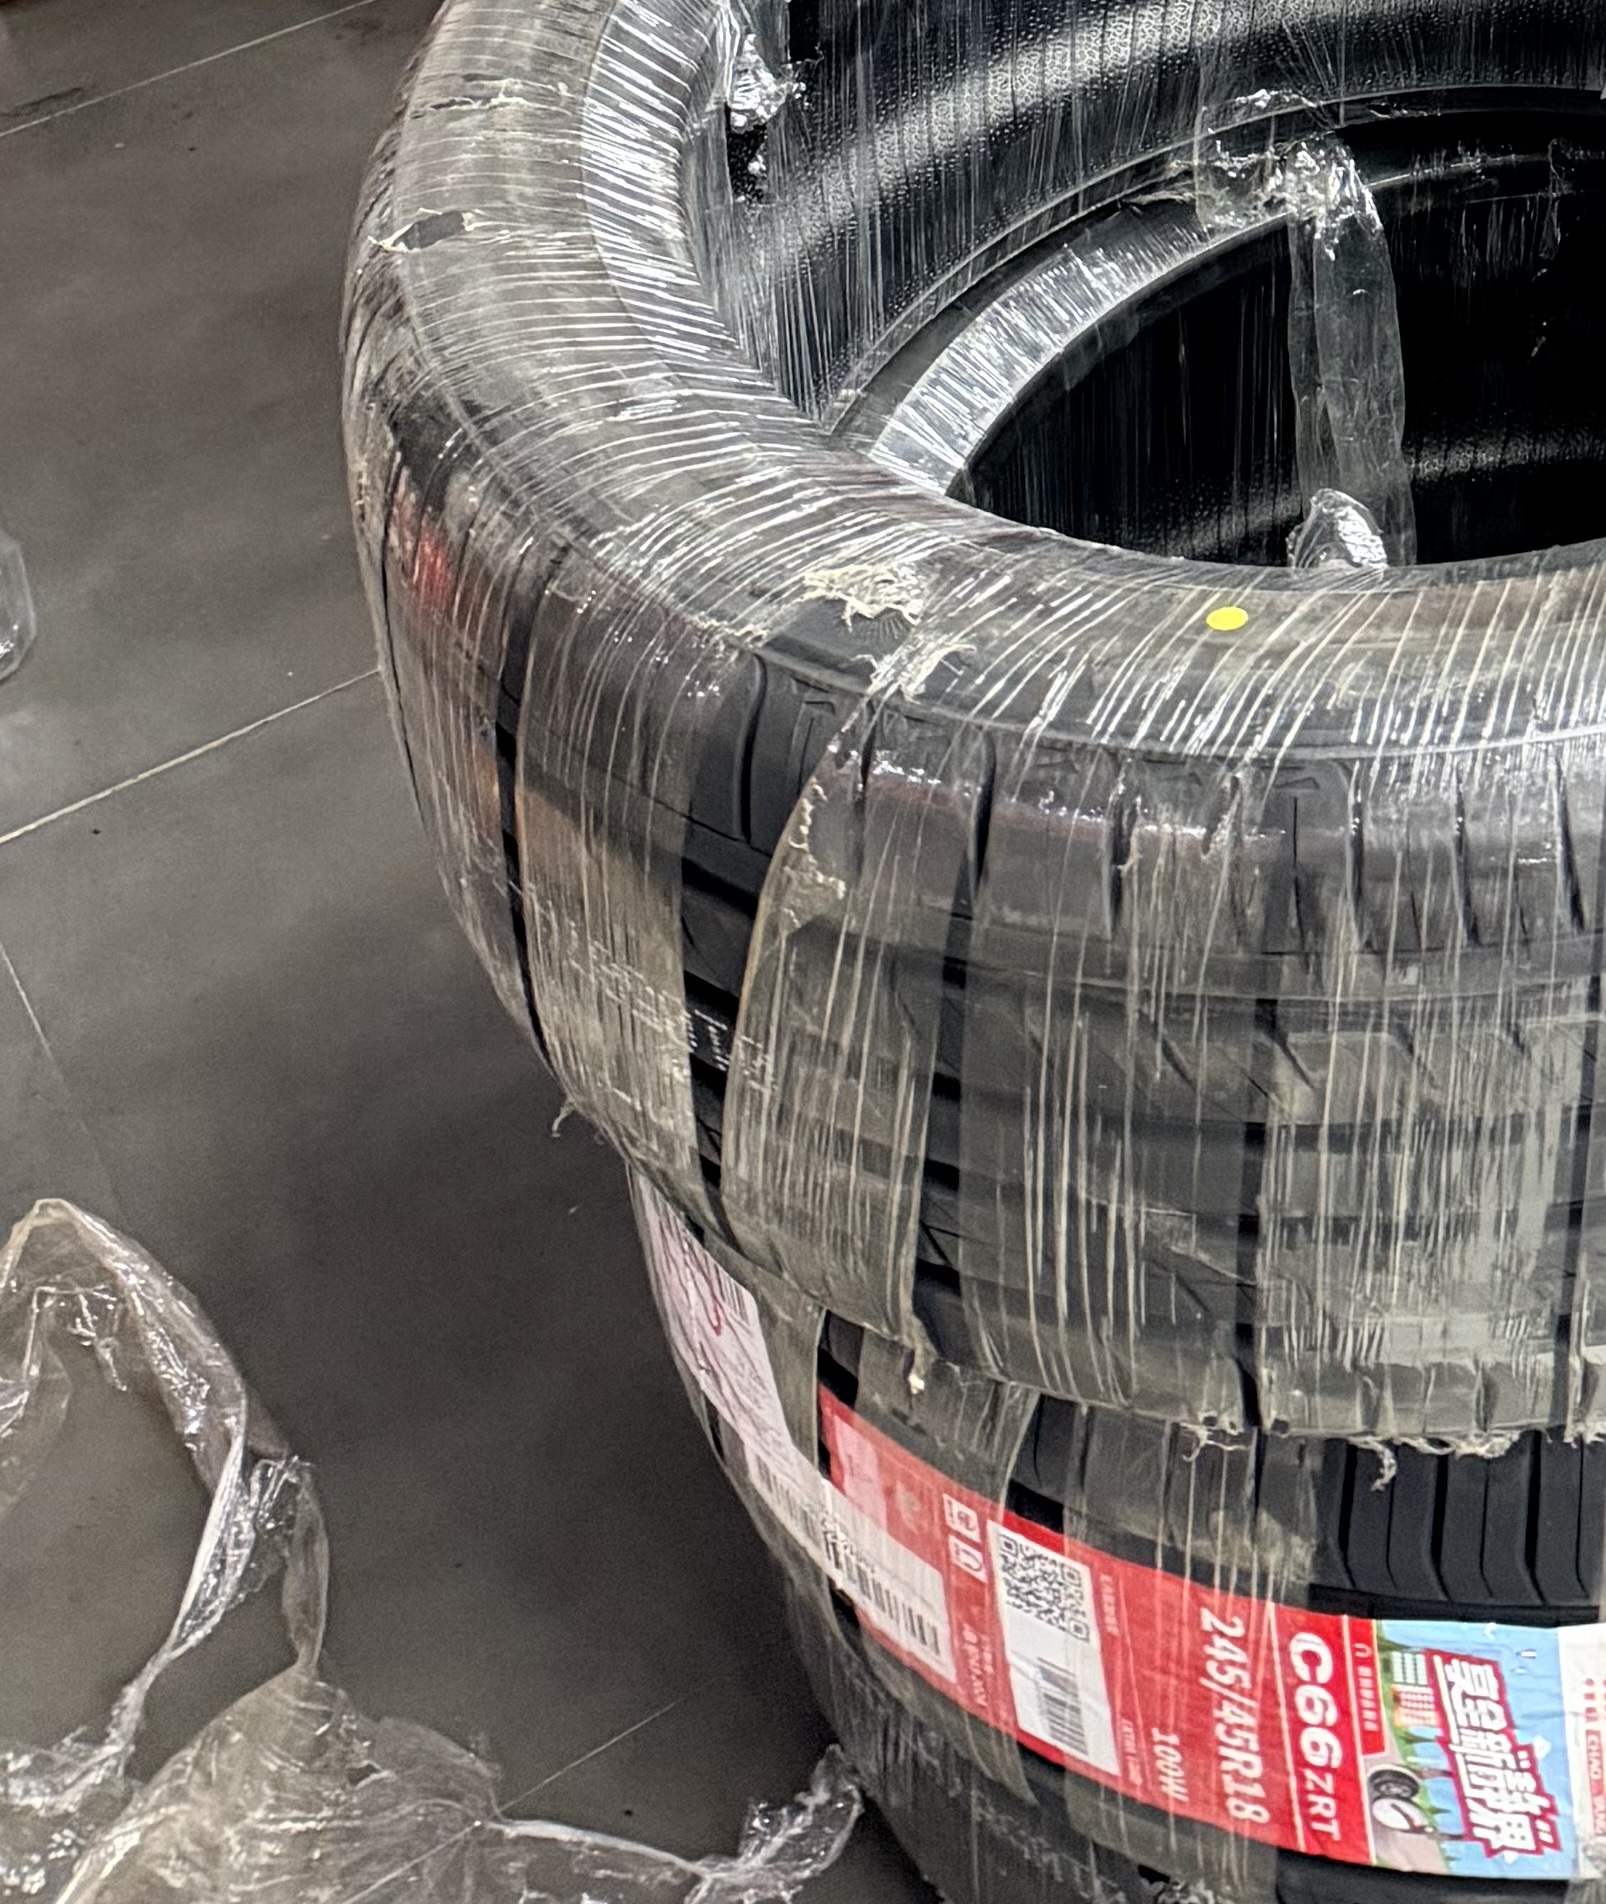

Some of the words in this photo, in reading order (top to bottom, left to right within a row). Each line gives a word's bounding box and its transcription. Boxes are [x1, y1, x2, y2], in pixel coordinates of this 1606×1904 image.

[1199, 1607, 1270, 1824] 245/45R18
[1289, 1632, 1343, 1769] C66
[1152, 1727, 1189, 1803] 100W
[1303, 1768, 1342, 1841] ZRT
